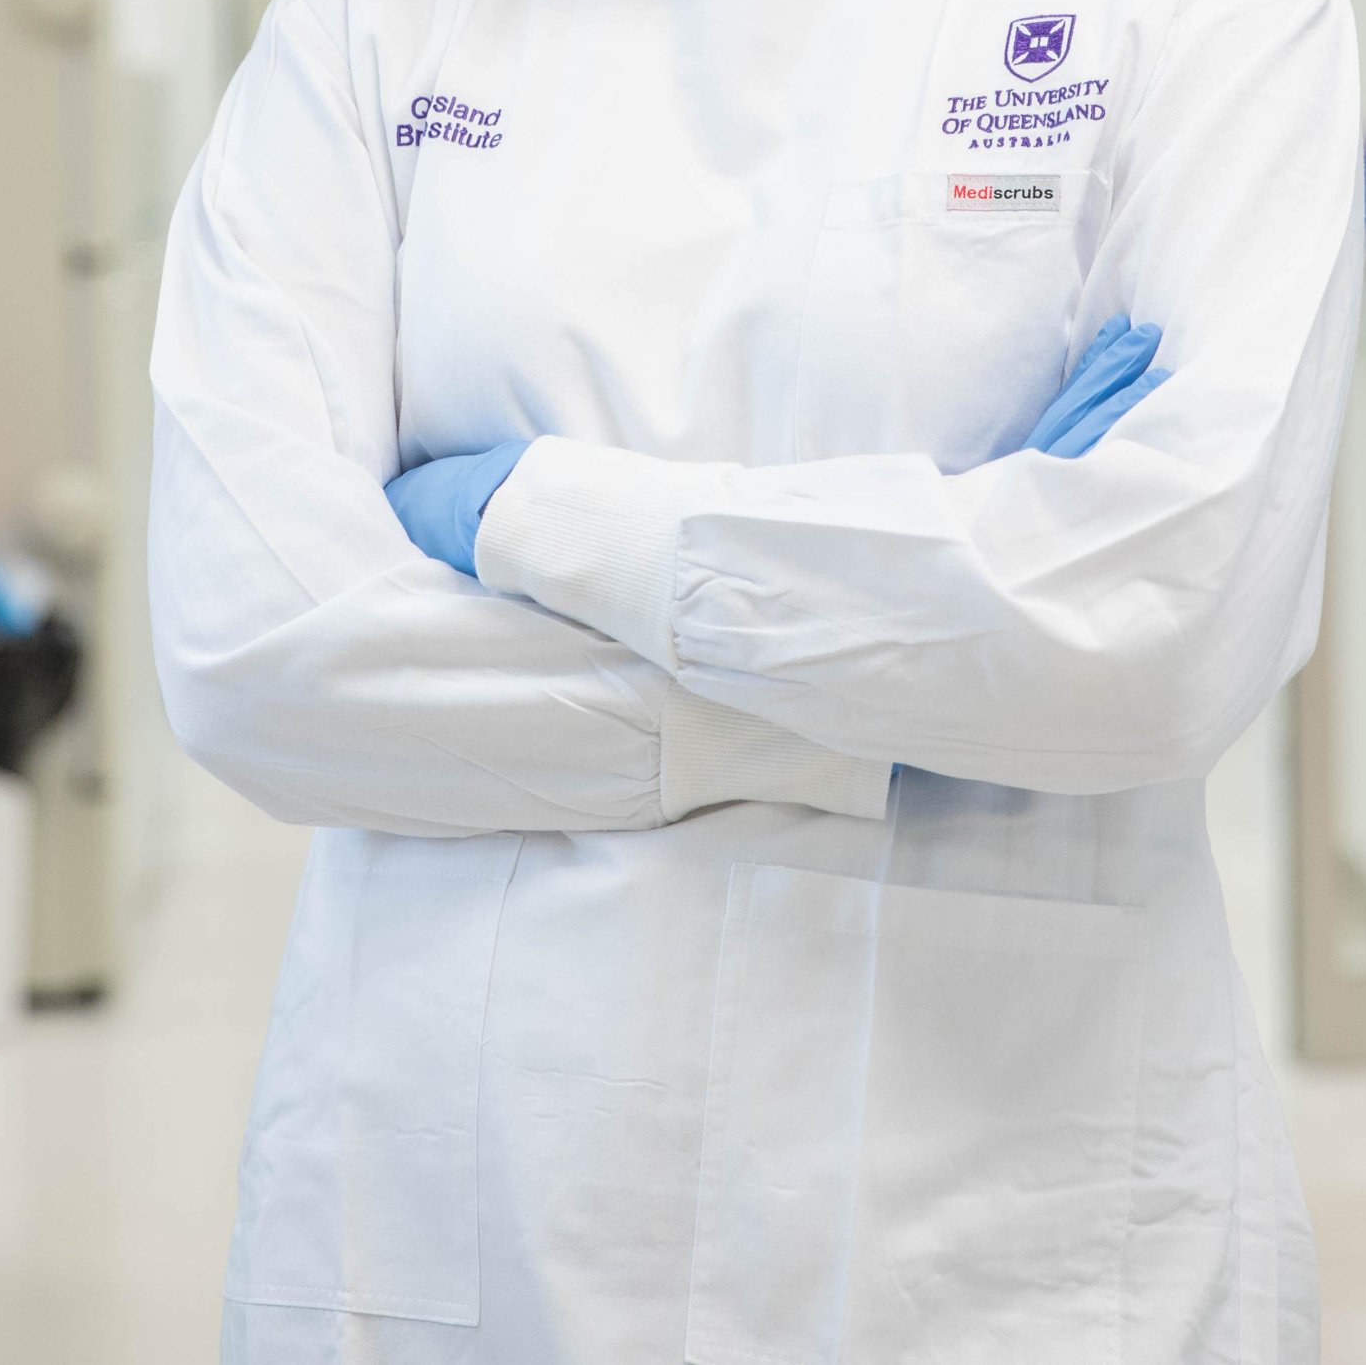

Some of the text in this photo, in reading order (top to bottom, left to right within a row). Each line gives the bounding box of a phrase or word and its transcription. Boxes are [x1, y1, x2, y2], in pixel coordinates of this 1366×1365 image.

[947, 79, 1110, 114] THE UNIVERSITY
[942, 103, 1106, 134] OF QUEENSLAND
[968, 131, 1071, 149] AUSTRALIA
[953, 185, 1054, 200] Mediscrubs
